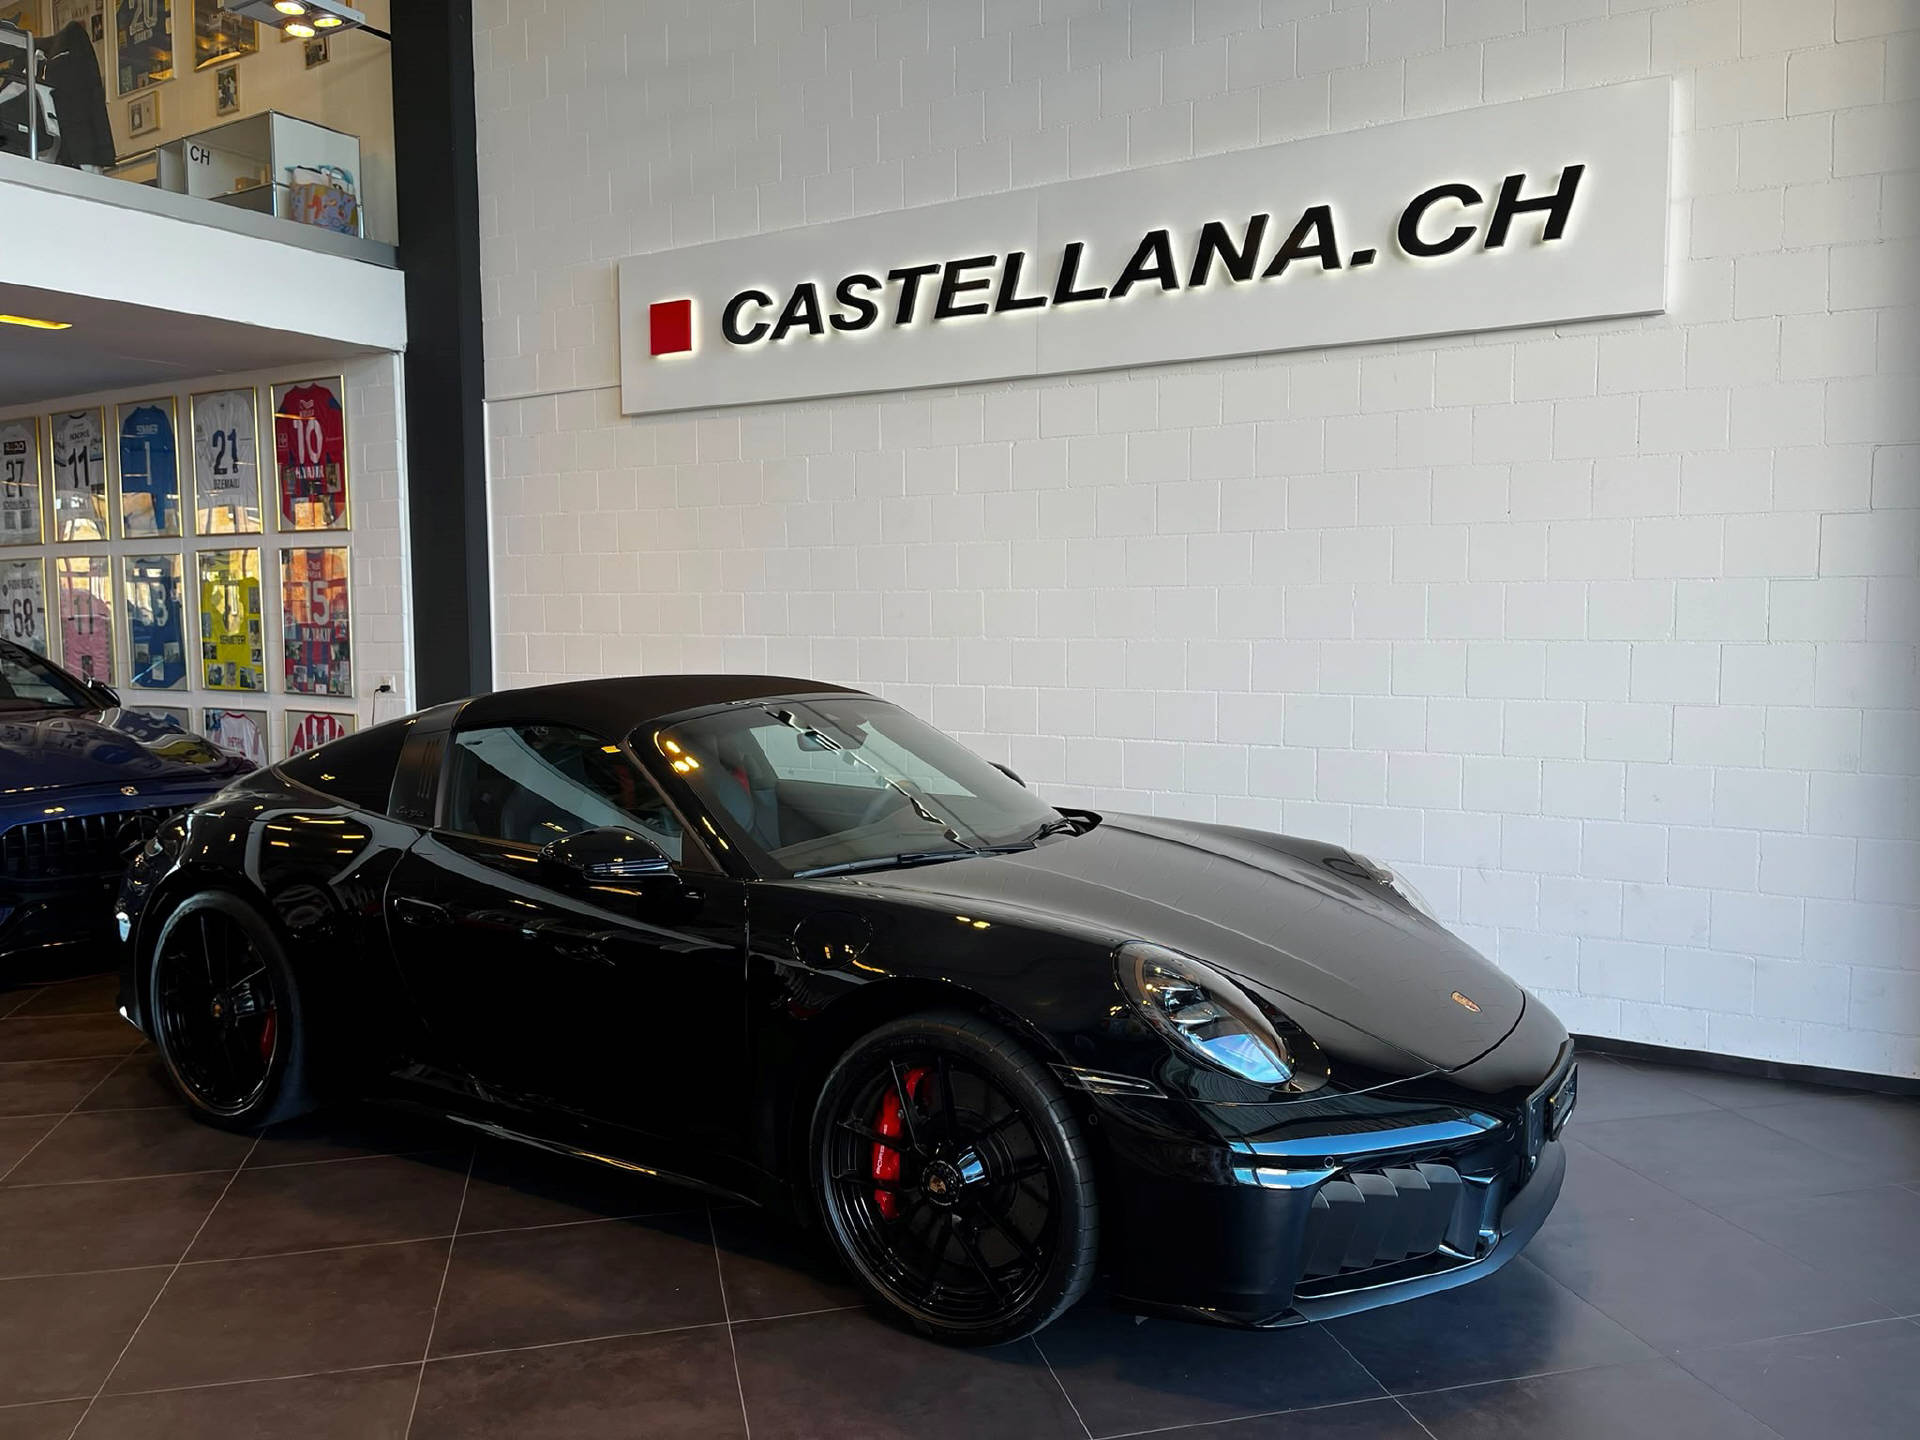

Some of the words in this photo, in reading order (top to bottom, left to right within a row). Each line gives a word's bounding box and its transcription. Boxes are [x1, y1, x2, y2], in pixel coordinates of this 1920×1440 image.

[721, 163, 1585, 346] CASTELLANA.CH
[212, 428, 239, 475] 21
[293, 418, 324, 464] 10
[6, 459, 25, 498] 27
[68, 445, 90, 489] 11
[12, 598, 35, 638] 68
